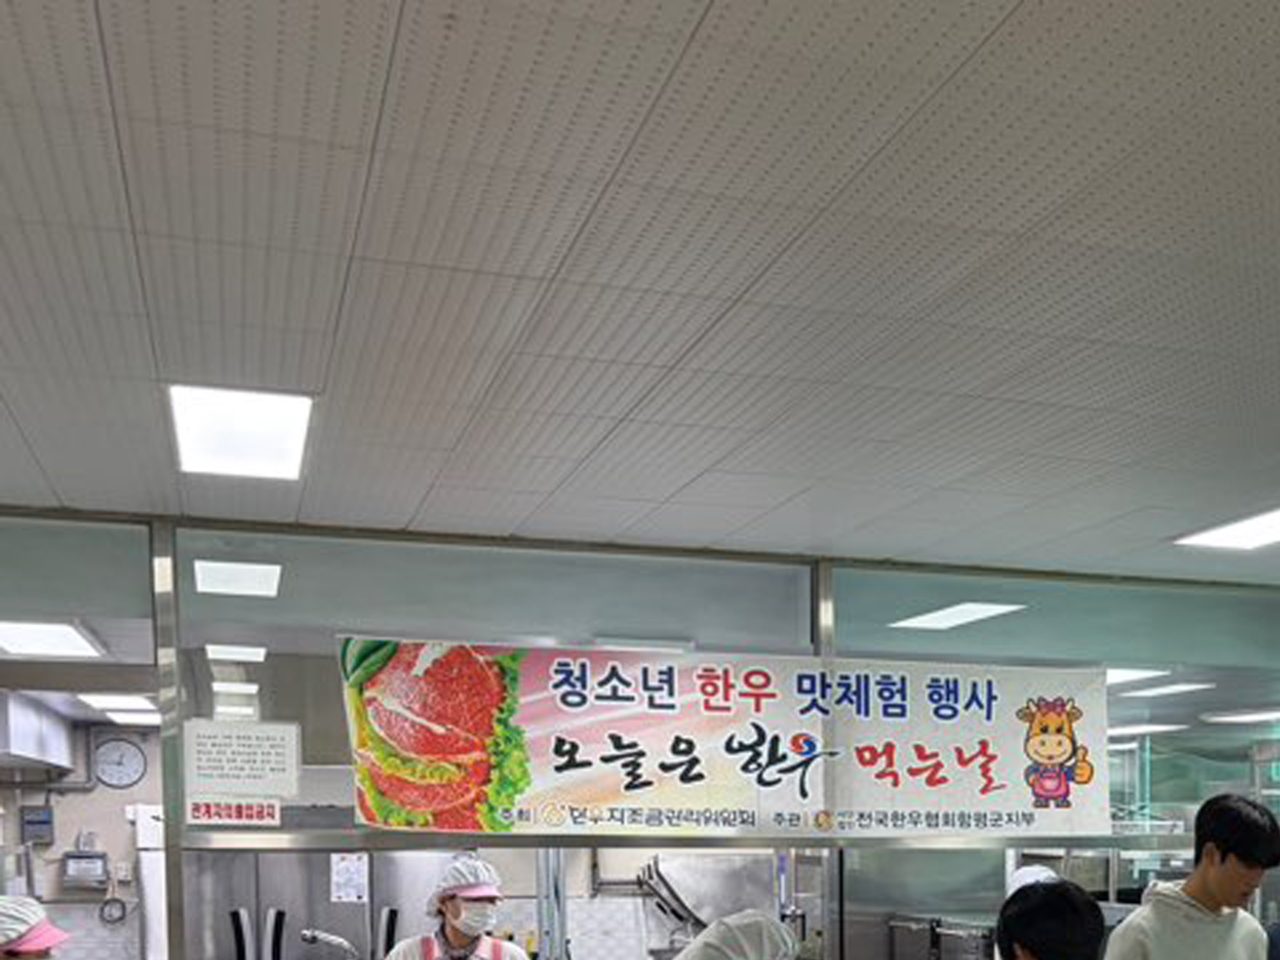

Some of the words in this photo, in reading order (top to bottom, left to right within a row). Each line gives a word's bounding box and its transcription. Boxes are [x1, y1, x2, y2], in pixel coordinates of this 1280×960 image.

[551, 661, 677, 710] 청소년
[696, 668, 777, 712] 한우
[796, 673, 909, 720] 맛체험
[926, 678, 998, 721] 행사
[552, 734, 705, 791] 오늘은
[725, 722, 839, 799] 한우
[855, 740, 1006, 795] 먹는날
